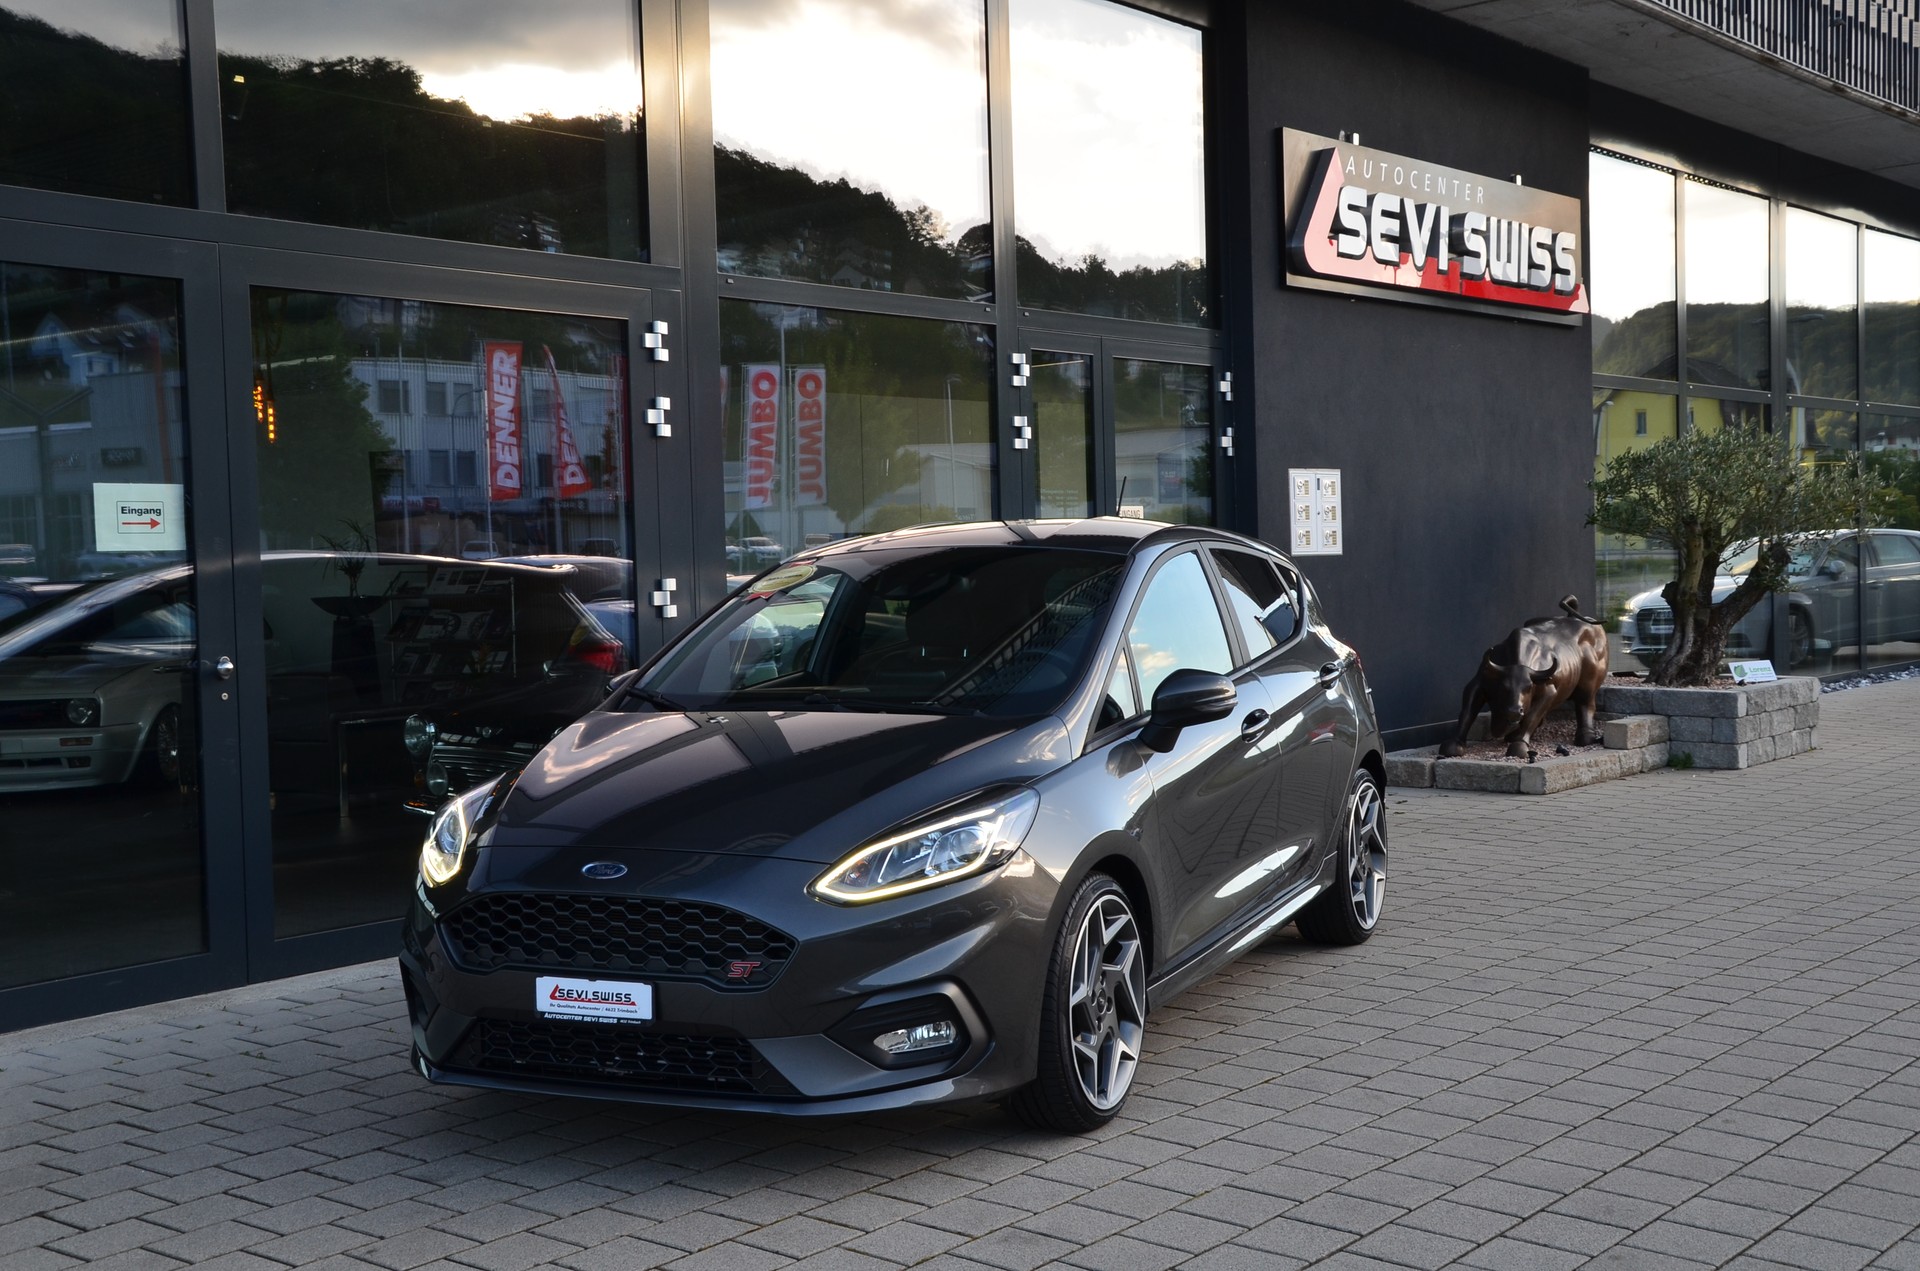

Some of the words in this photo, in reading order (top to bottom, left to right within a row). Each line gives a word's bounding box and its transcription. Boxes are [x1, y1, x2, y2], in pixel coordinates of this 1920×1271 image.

[1345, 155, 1484, 204] AUTOCENTER
[1337, 185, 1450, 275] SEVI
[1460, 210, 1576, 296] SWISS
[492, 348, 521, 489] DENNER
[748, 371, 777, 504] JUMBO
[798, 373, 824, 500] JUMBO
[120, 506, 162, 516] Eingang
[557, 988, 589, 1000] SEVI
[591, 991, 632, 1003] SWISS
[727, 961, 761, 978] ST
